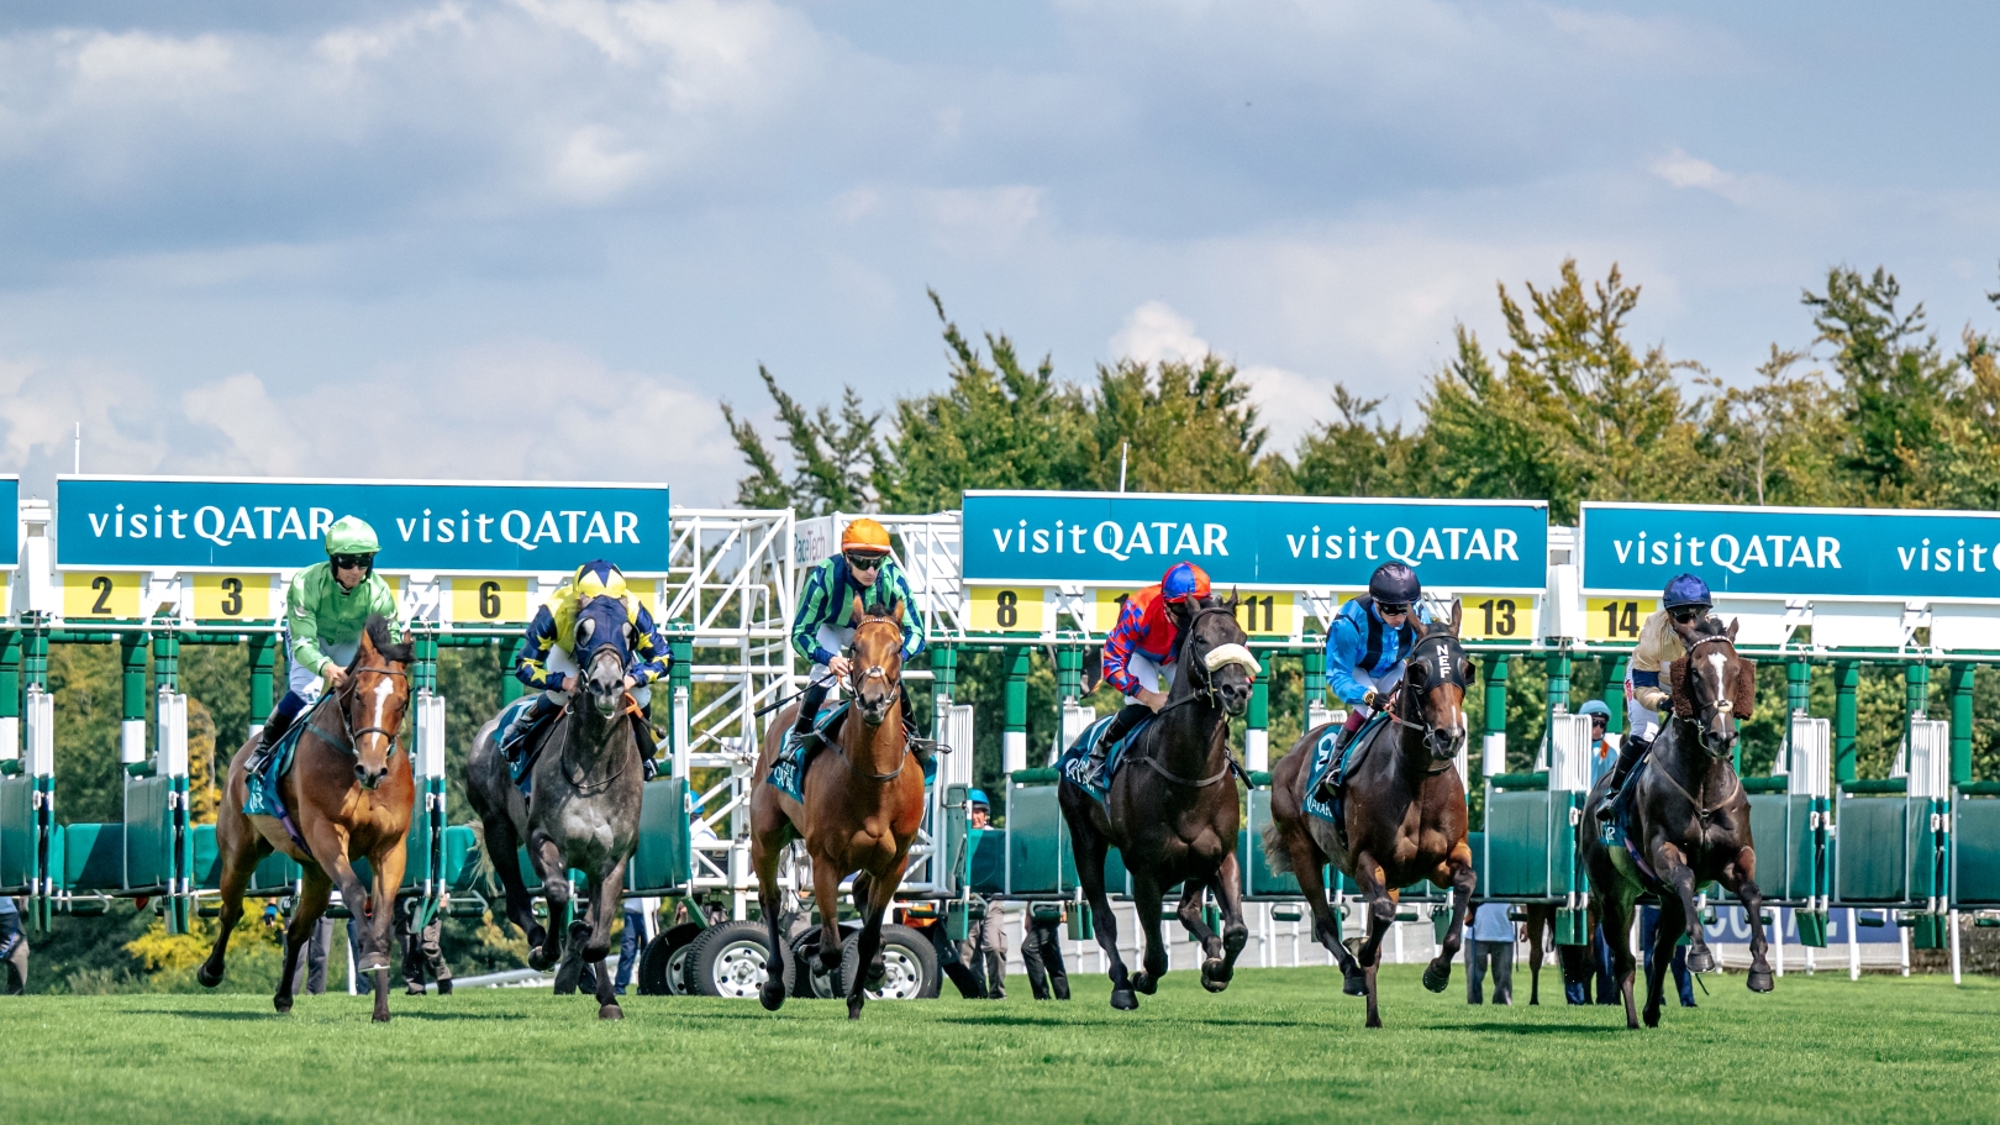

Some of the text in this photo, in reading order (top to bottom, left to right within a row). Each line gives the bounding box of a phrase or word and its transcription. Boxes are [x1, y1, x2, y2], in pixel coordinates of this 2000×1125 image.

[88, 503, 334, 547] visitQATAR
[396, 508, 641, 551] visitQATAR
[992, 519, 1229, 561] visitQATAR
[1286, 525, 1519, 567] visitQATAR
[1613, 530, 1843, 574] visitQATAR
[1897, 537, 2000, 573] visit
[91, 576, 113, 614] 2
[221, 577, 243, 615] 3
[479, 581, 501, 619] 6
[997, 590, 1018, 628] 8
[1244, 595, 1274, 631] 11
[1478, 599, 1516, 636] 13
[1603, 602, 1640, 638] 14
[1436, 644, 1452, 679] NEF
